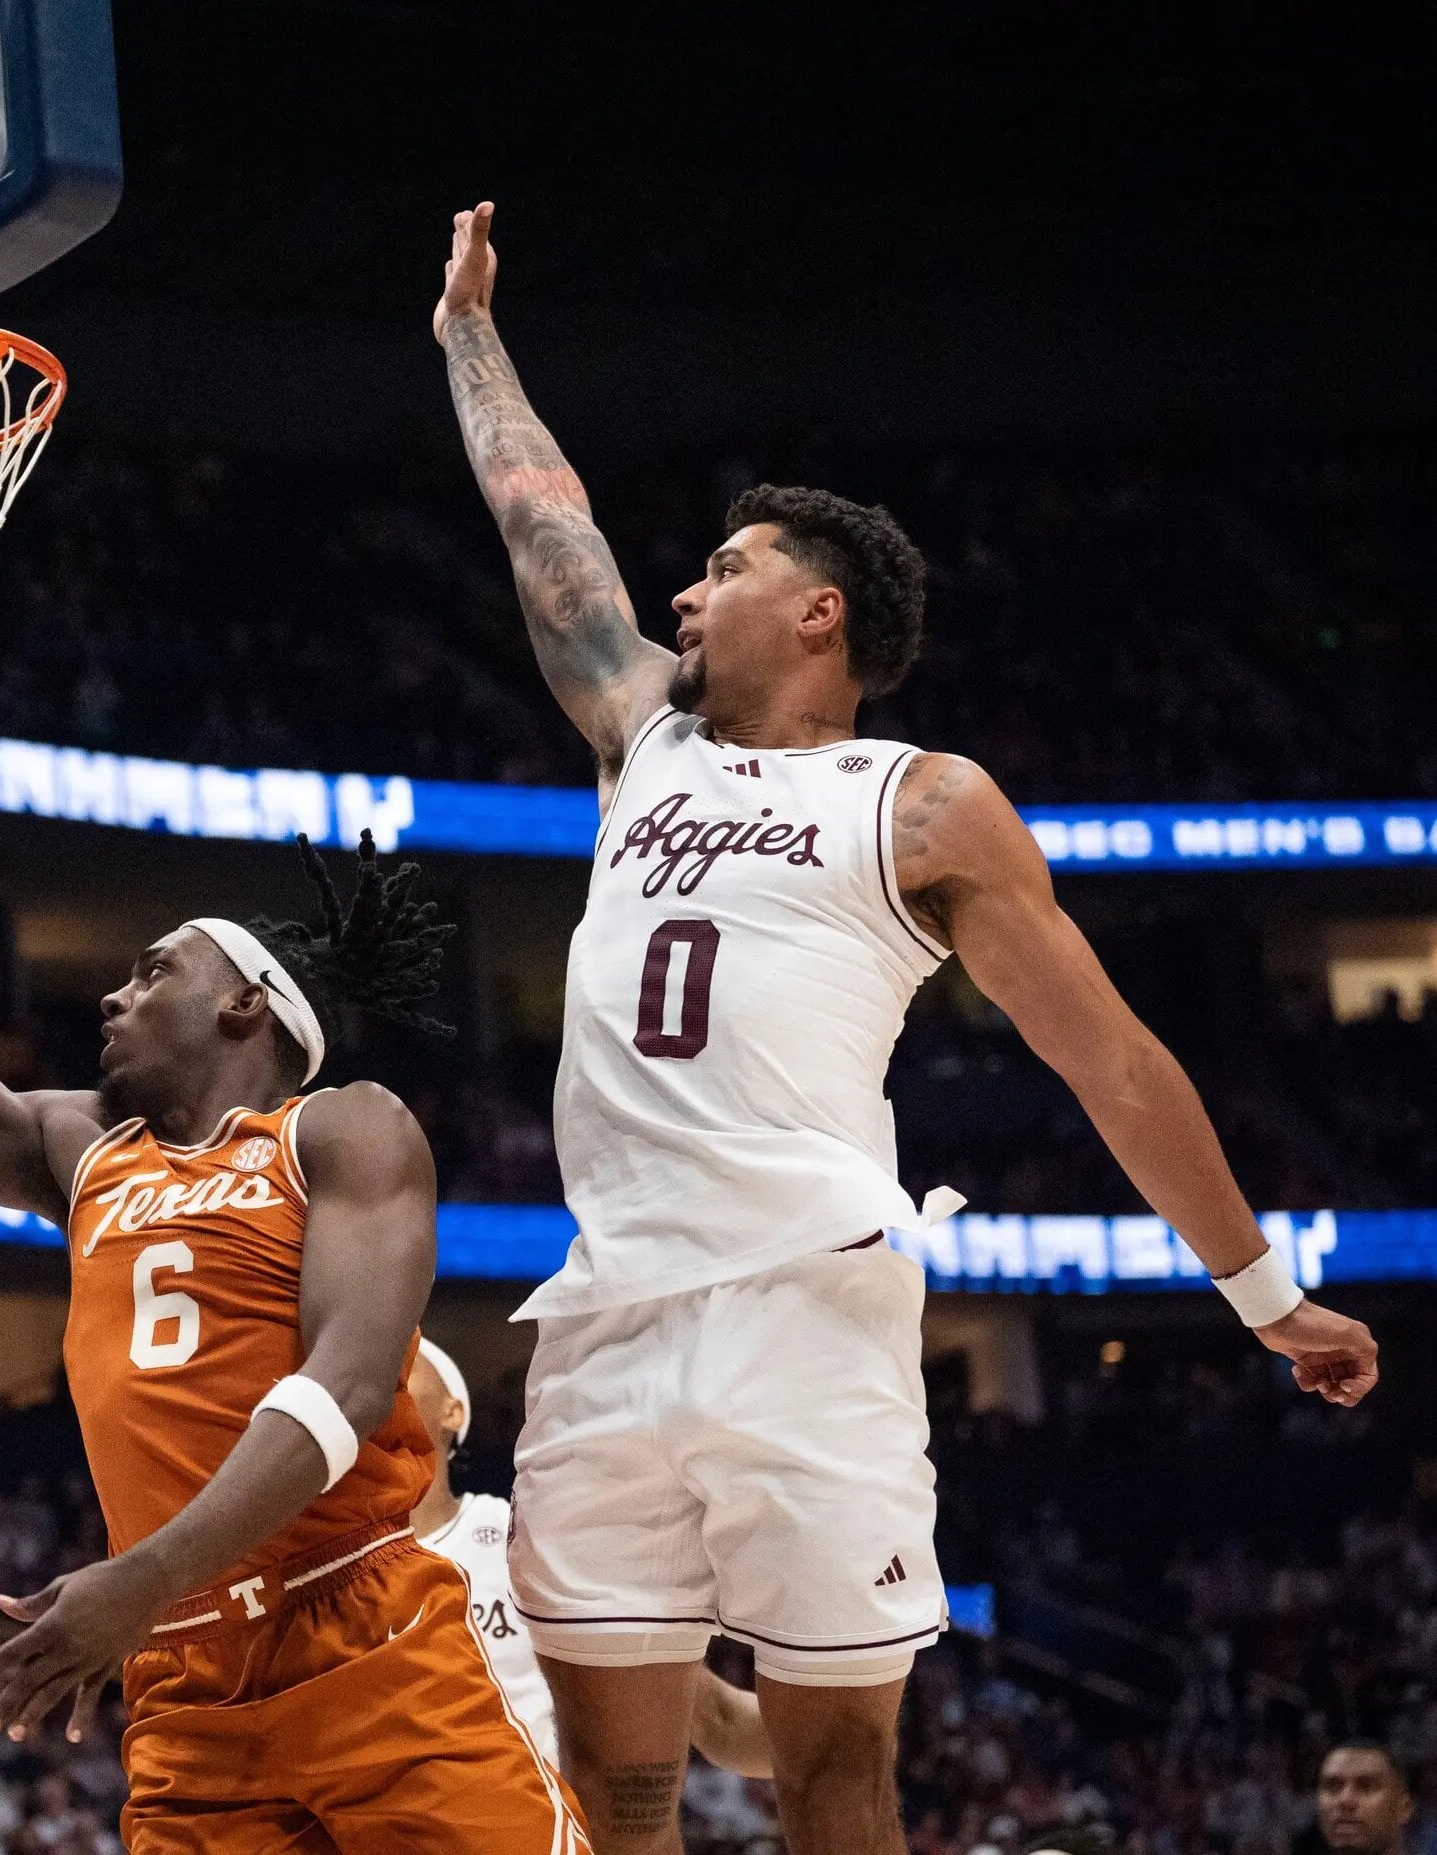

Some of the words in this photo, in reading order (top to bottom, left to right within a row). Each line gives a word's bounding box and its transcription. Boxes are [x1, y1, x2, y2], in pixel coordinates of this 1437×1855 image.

[839, 756, 871, 772] SEC
[610, 793, 824, 898] Aggies
[632, 919, 721, 1060] 0
[234, 1137, 275, 1170] SEC
[82, 1169, 285, 1258] Texas
[129, 1240, 200, 1371] 6
[228, 1575, 267, 1620] T
